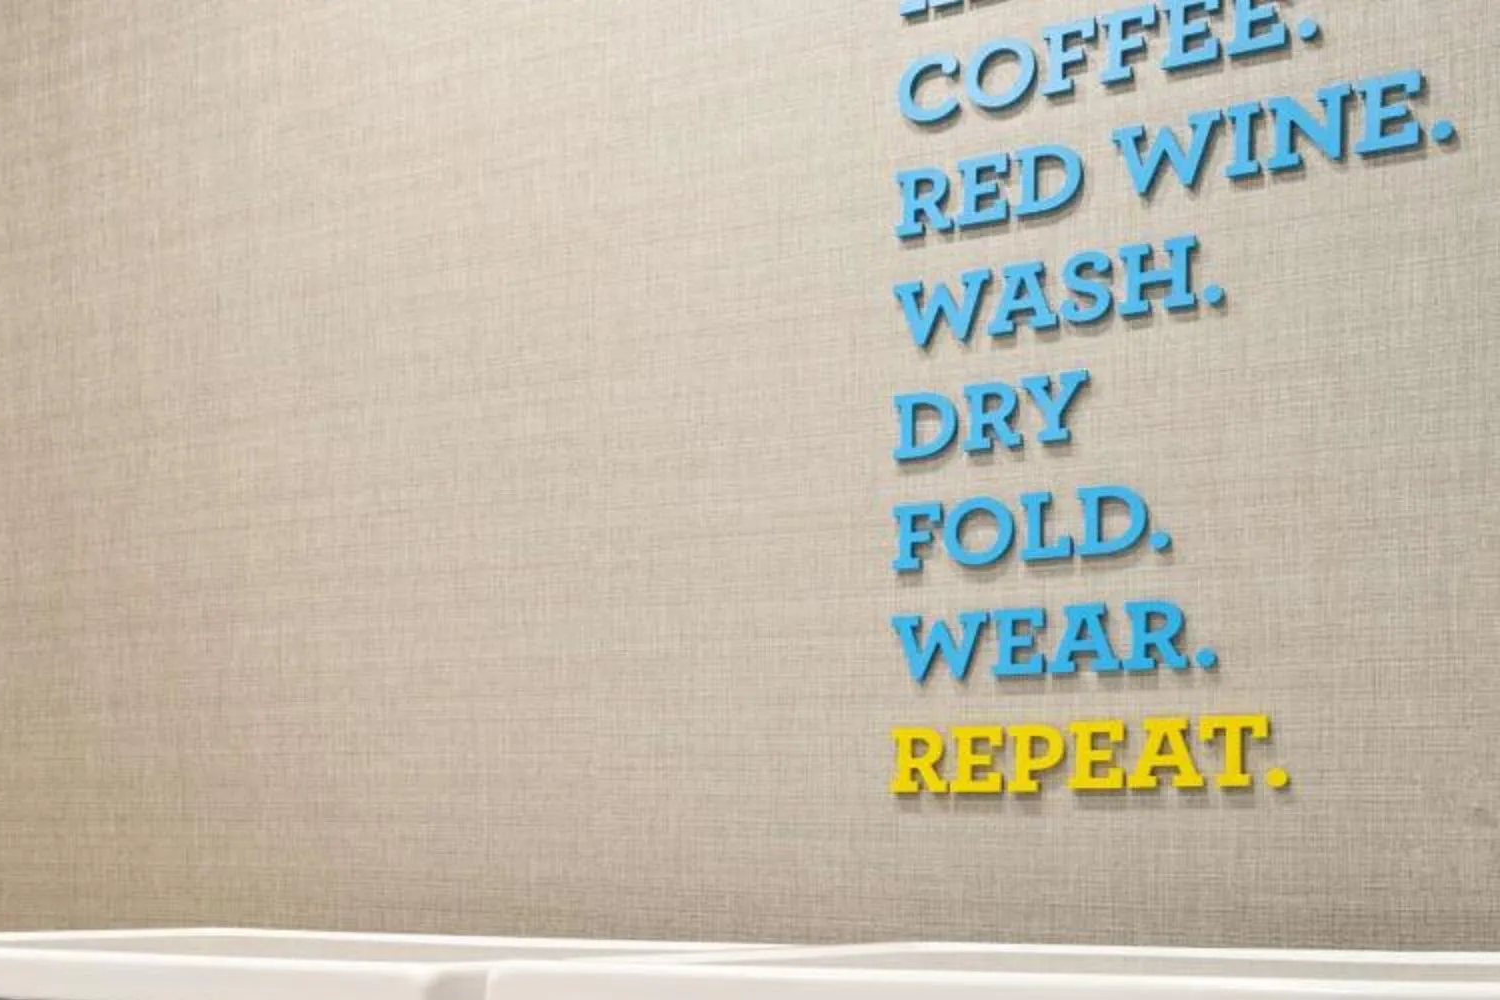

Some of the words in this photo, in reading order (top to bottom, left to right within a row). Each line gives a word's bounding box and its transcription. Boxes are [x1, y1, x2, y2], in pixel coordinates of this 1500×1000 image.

[898, 0, 1319, 124] COFFEE.
[896, 143, 1087, 238] RED
[1113, 69, 1457, 197] WINE.
[894, 235, 1226, 349] WASH.
[893, 368, 1091, 463] DRY
[892, 485, 1173, 573] FOLD.
[892, 599, 1219, 684] WEAR.
[890, 711, 1292, 796] REPEAT.
